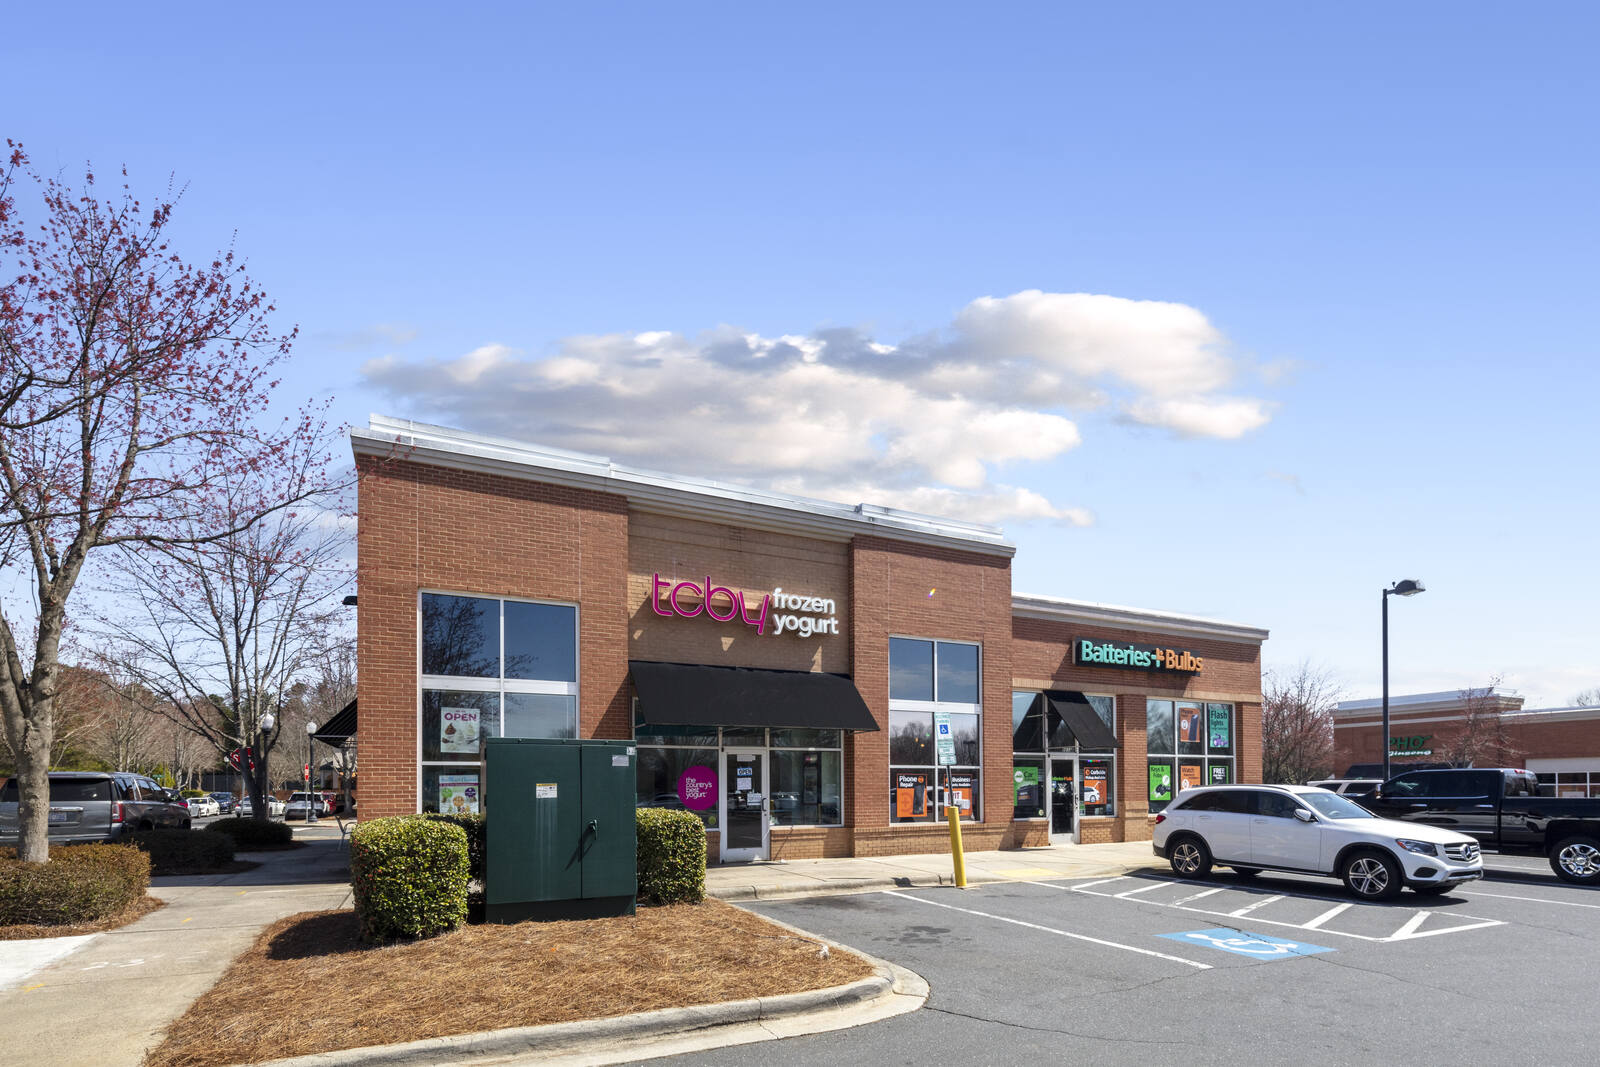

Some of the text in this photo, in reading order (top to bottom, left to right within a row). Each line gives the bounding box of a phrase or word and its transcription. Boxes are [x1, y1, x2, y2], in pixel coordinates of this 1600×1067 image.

[653, 573, 769, 635] tcby
[772, 588, 835, 615] frozen
[772, 614, 839, 637] yogurt
[444, 712, 477, 721] OPEN
[1211, 711, 1227, 719] Flash
[1211, 720, 1224, 728] lights
[899, 775, 918, 783] Phone
[686, 781, 713, 790] country's
[686, 791, 706, 799] yogurt
